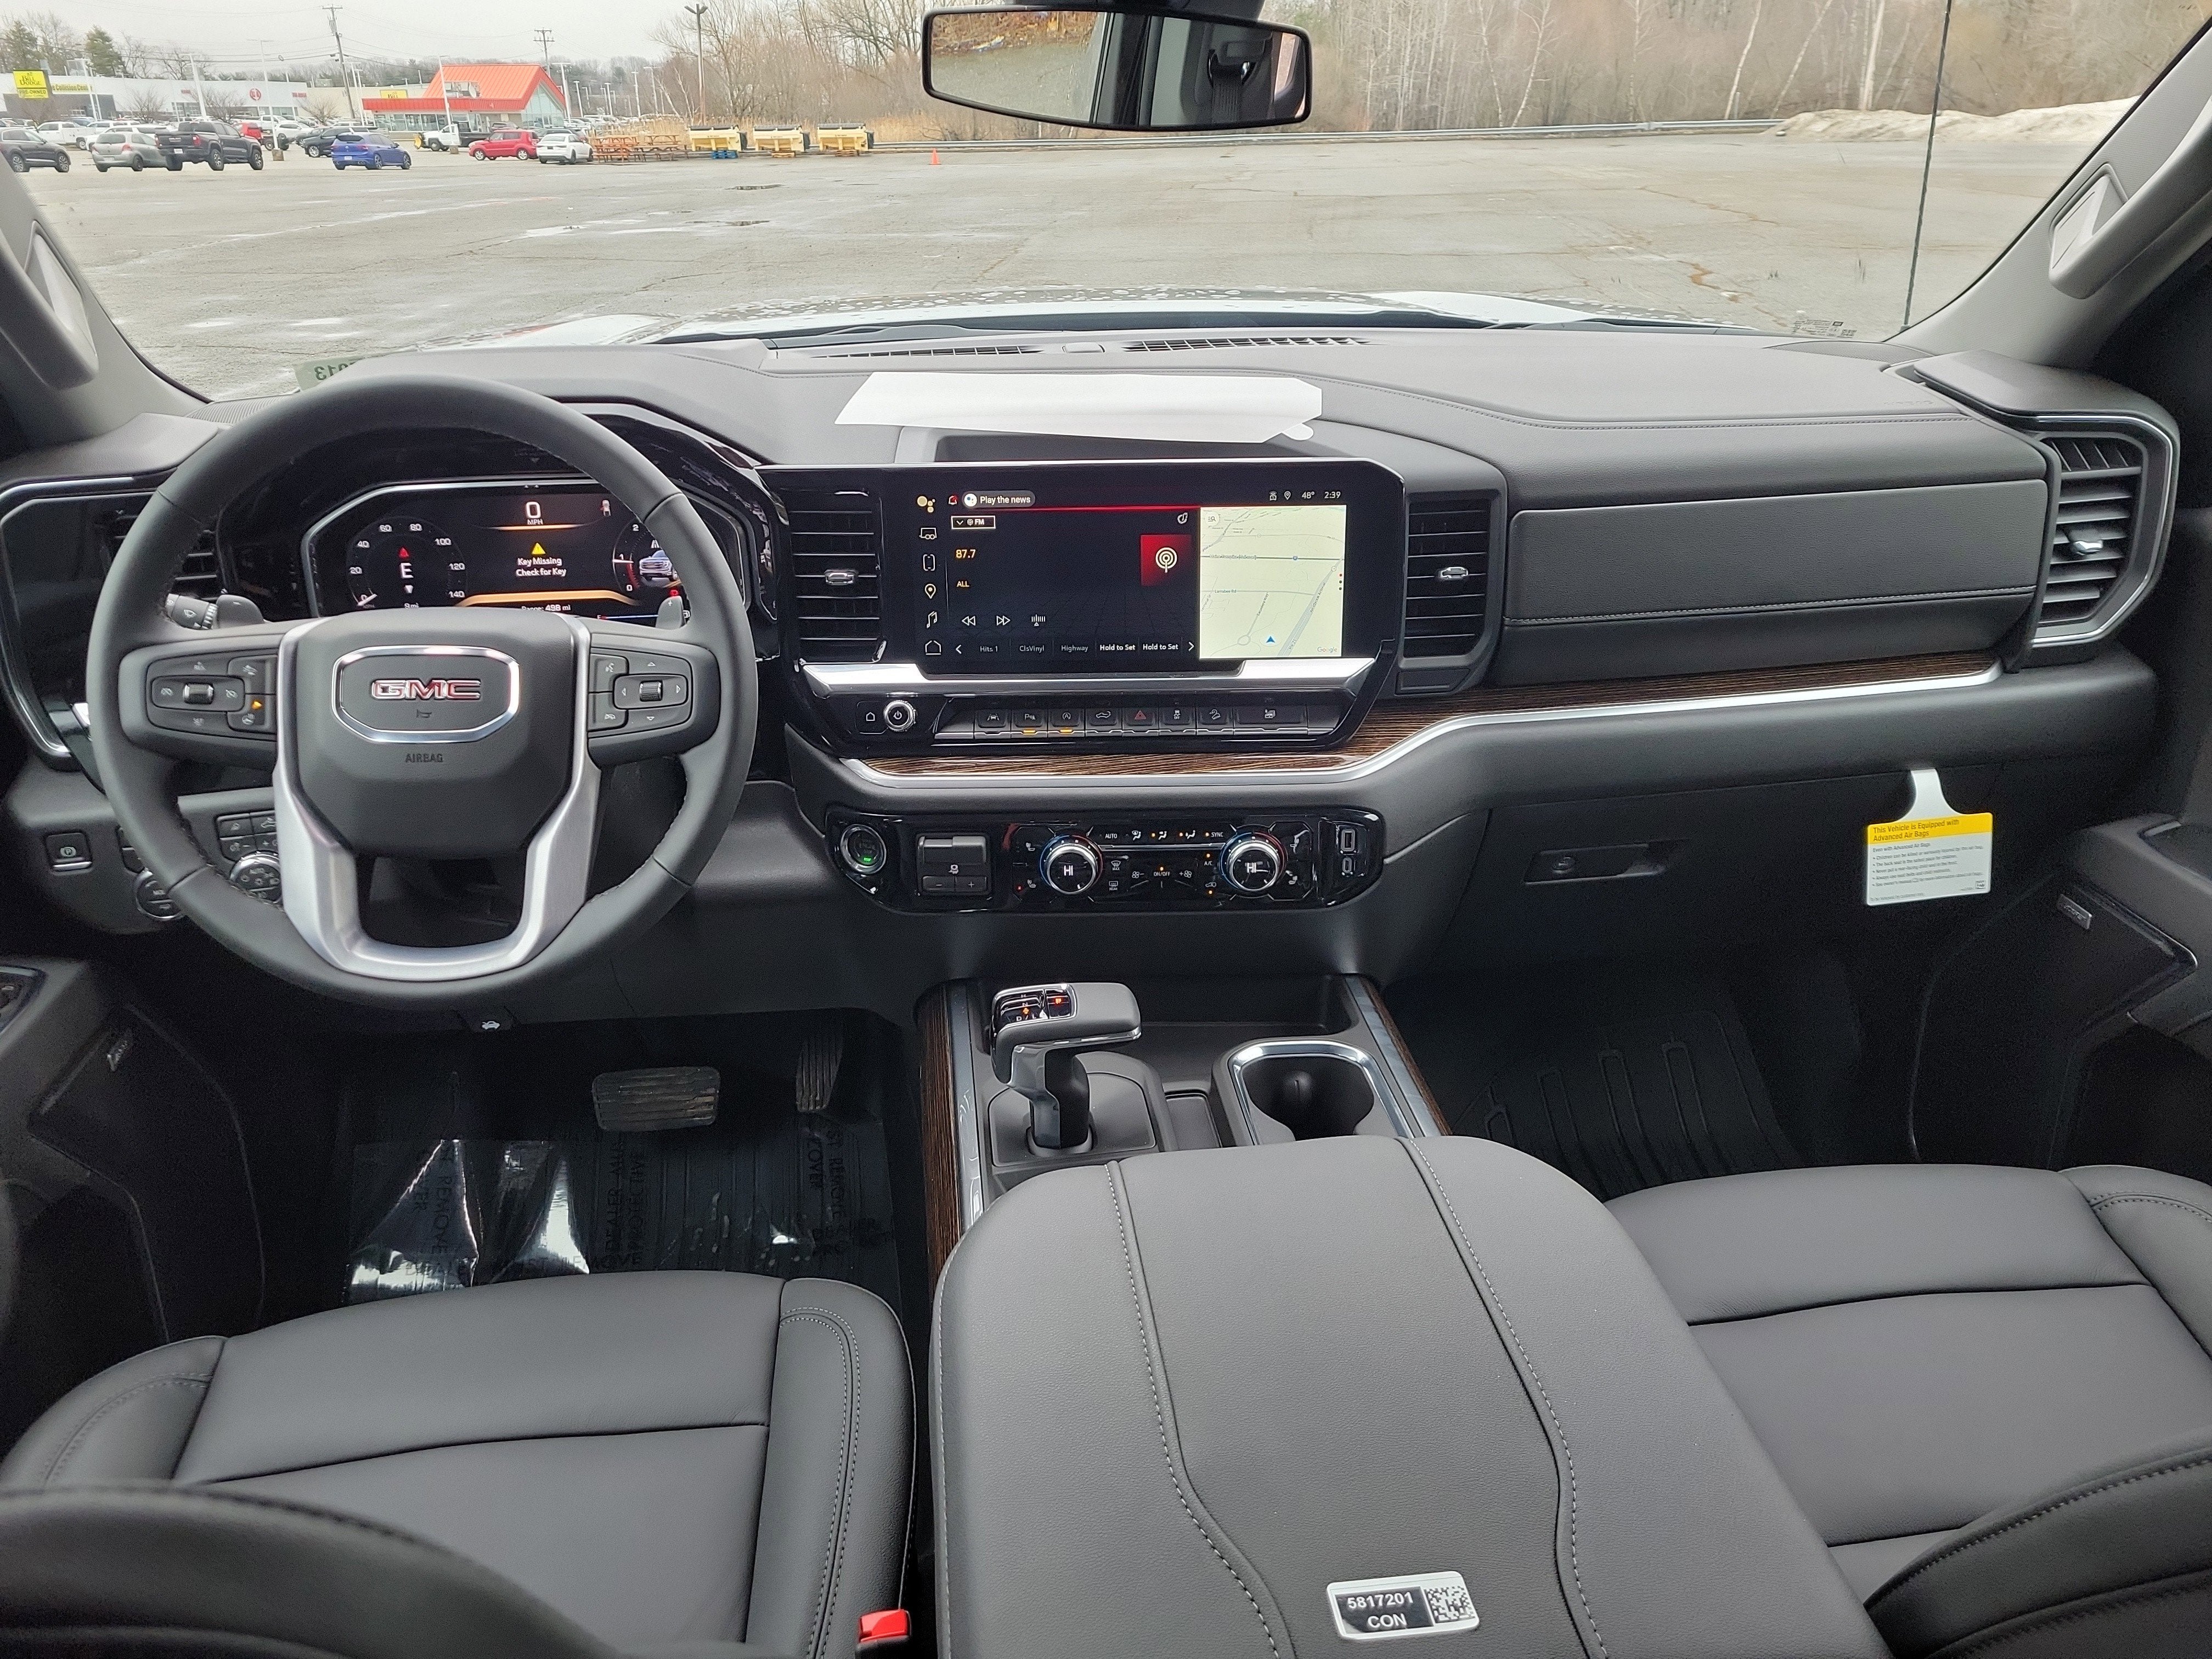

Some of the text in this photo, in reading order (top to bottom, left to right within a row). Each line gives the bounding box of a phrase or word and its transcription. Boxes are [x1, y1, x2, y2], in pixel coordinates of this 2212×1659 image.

[980, 495, 996, 505] Play
[997, 495, 1009, 504] the
[1324, 491, 1341, 499] 2:39
[435, 538, 452, 546] 100
[955, 549, 977, 559] 87.7
[449, 562, 465, 571] 120
[517, 557, 562, 567] Key Missing
[349, 566, 362, 574] 20
[400, 562, 414, 578] E
[516, 568, 540, 577] Check
[552, 568, 567, 577] Key
[1019, 645, 1045, 653] ClsVinyl
[1061, 645, 1088, 653] Highway
[371, 679, 482, 700] GMC
[405, 753, 444, 763] AIRBAG
[1887, 825, 1910, 833] Vehicle
[1918, 820, 1945, 830] Equipped
[1873, 832, 1903, 842] Advanced
[1063, 865, 1074, 876] HI
[1246, 862, 1256, 873] HI
[431, 1176, 453, 1255] REMOVE
[1347, 1592, 1414, 1609] 5817201
[1367, 1613, 1407, 1628] CON
